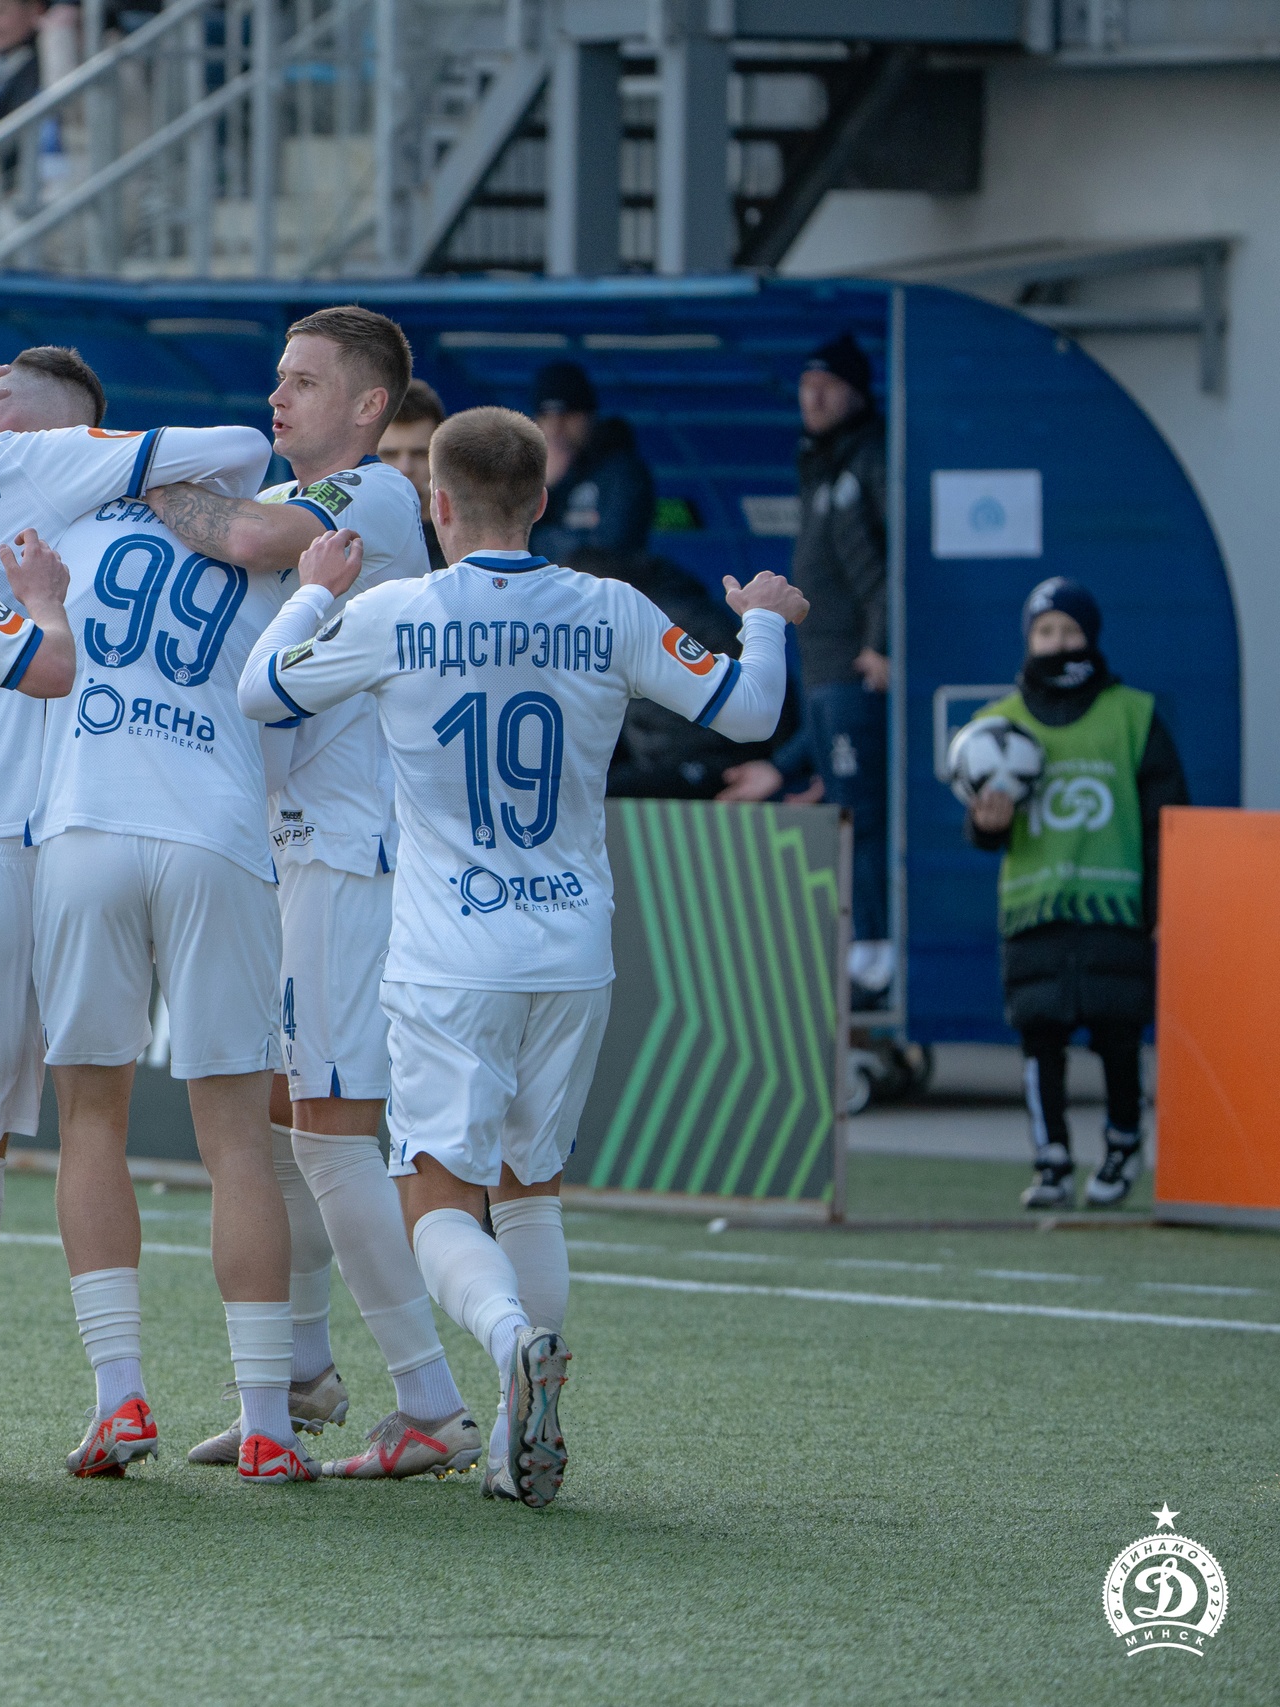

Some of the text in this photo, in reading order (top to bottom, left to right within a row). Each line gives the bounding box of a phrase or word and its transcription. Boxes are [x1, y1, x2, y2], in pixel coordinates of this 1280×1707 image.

[95, 498, 165, 524] СА
[84, 534, 248, 687] 99
[432, 691, 564, 850] 19
